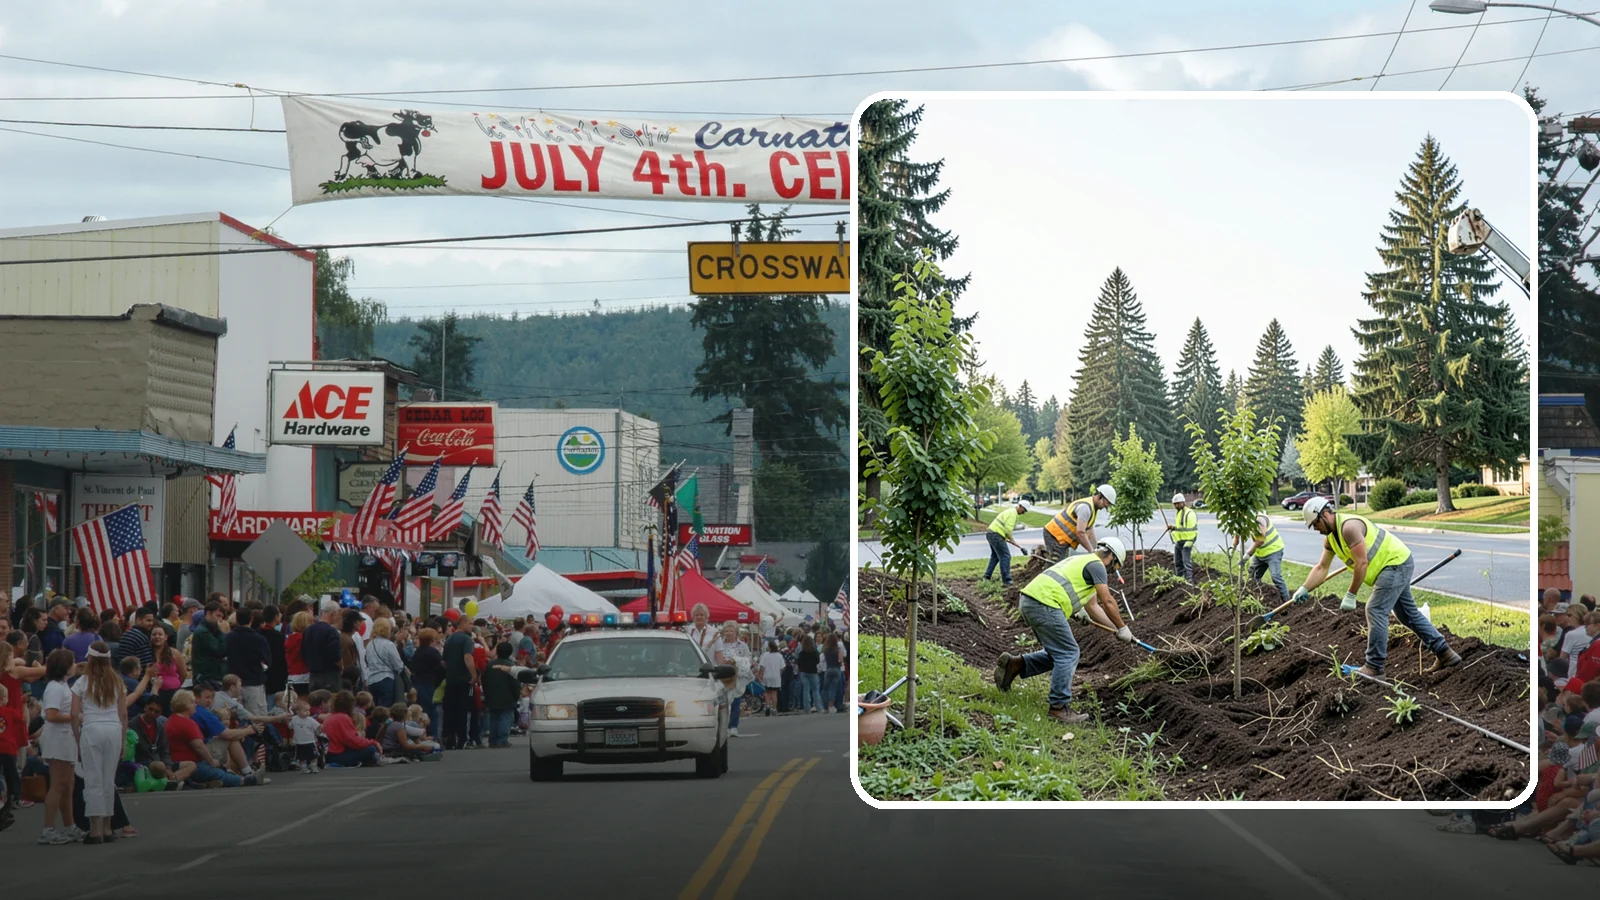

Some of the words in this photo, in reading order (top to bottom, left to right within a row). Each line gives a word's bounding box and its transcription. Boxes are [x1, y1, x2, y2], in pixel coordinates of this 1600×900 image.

[481, 141, 604, 192] JULY
[632, 150, 746, 197] 4th.
[697, 254, 850, 280] CROSSWA
[283, 380, 374, 419] ACE
[406, 409, 452, 421] CEDAR
[283, 421, 371, 436] Hardware
[353, 466, 385, 480] Simpl
[95, 485, 124, 495] Vincent
[126, 486, 136, 495] de
[137, 485, 155, 495] Paul
[688, 526, 741, 535] CRNATION
[699, 535, 730, 543] GLASS
